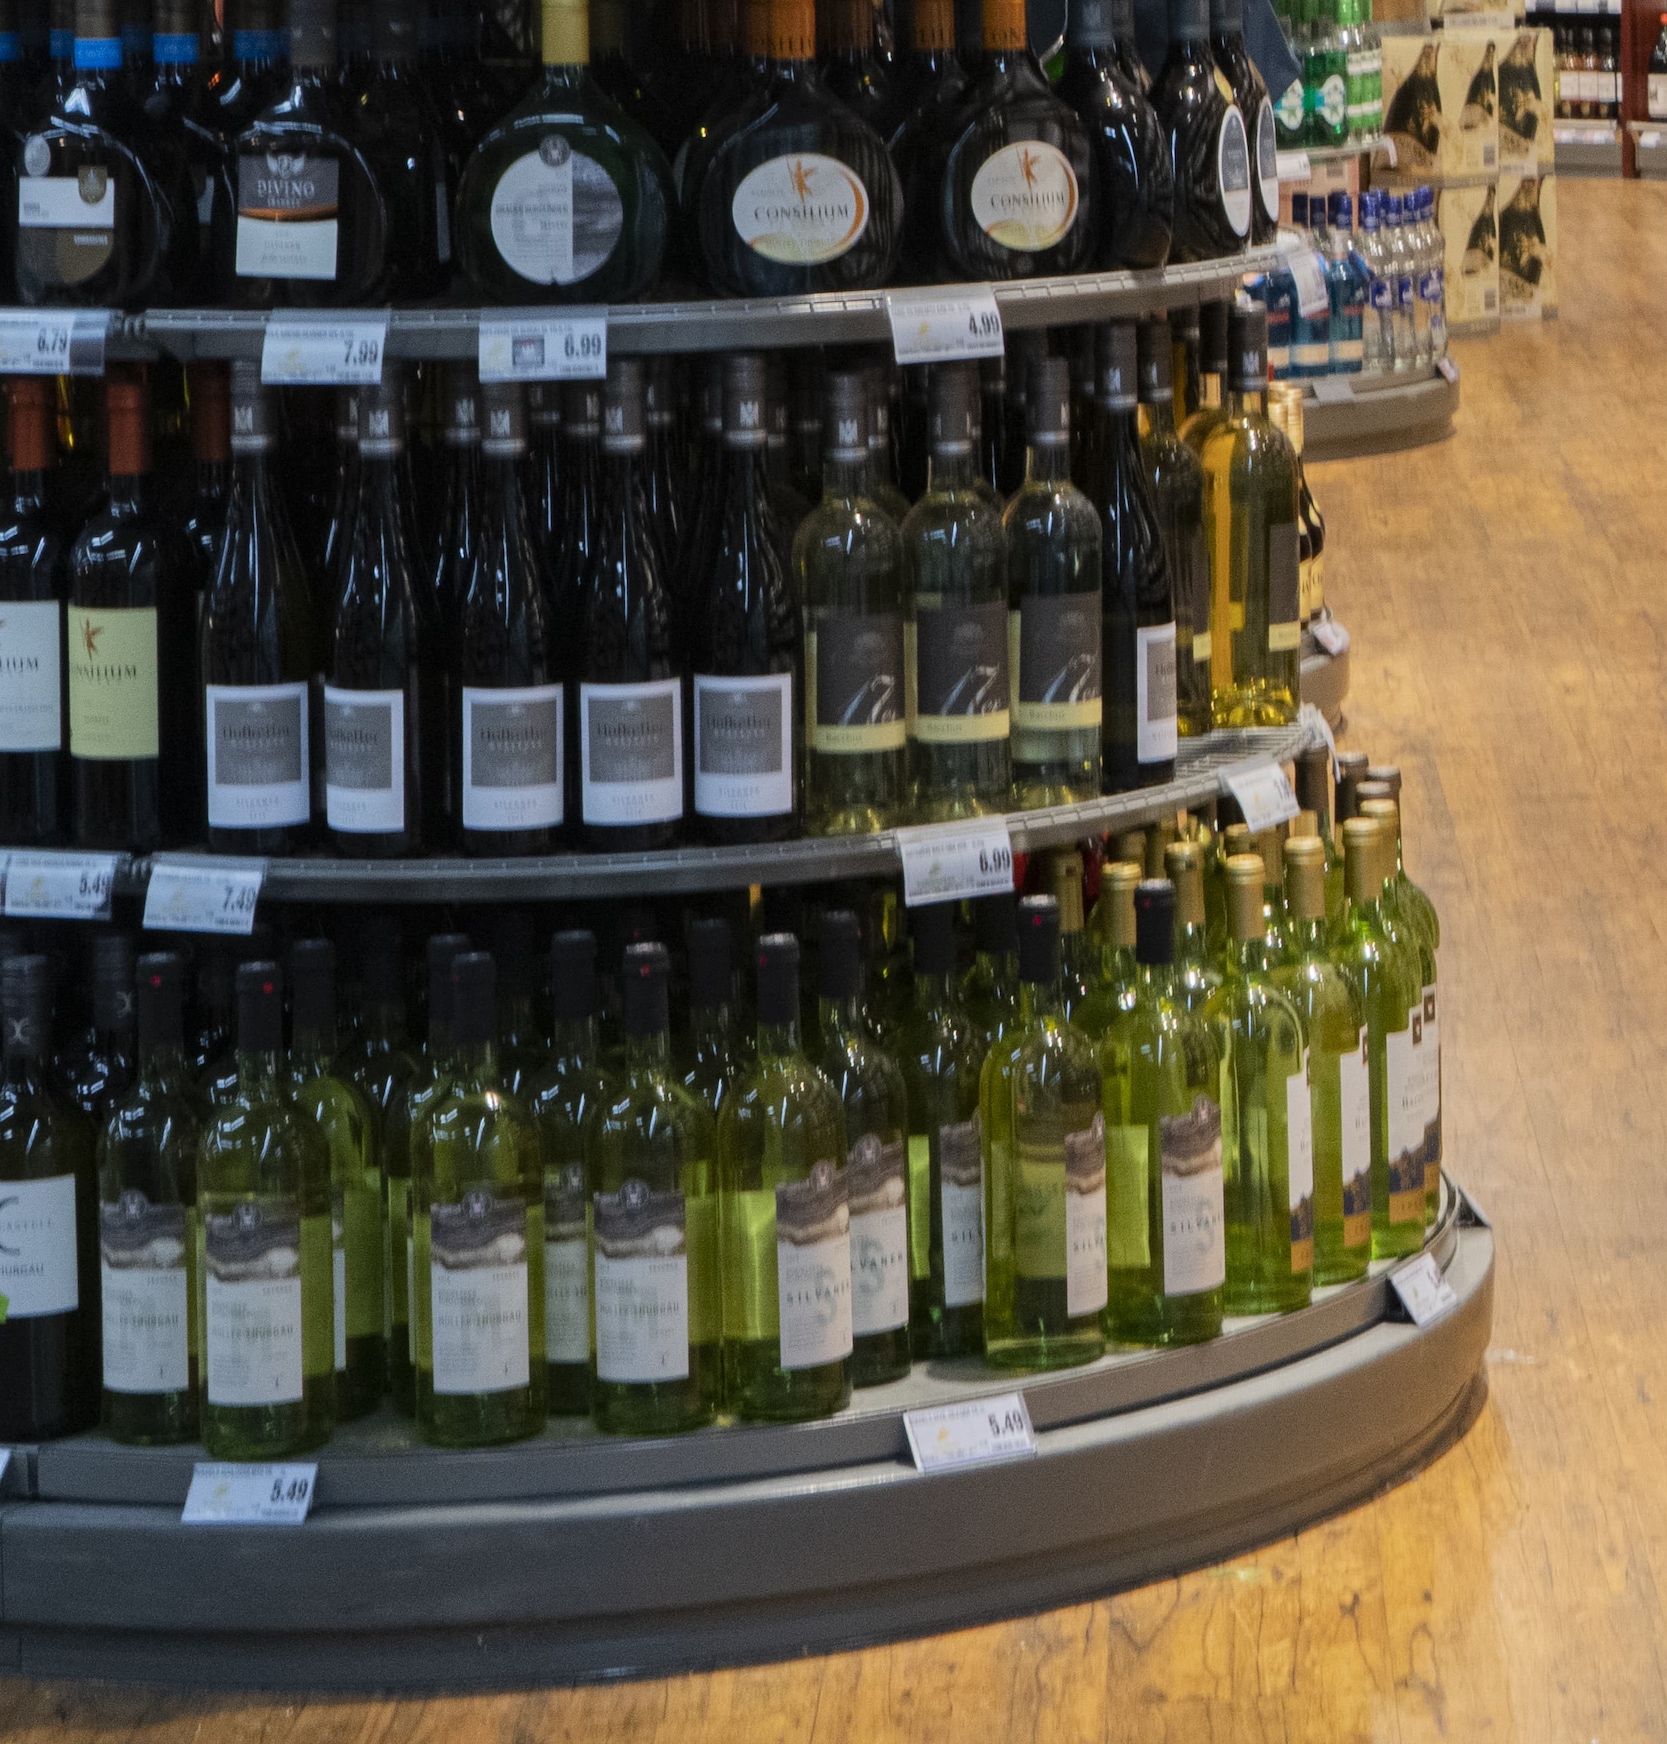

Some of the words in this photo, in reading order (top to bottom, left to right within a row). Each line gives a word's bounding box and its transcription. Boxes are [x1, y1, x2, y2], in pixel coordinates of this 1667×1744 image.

[256, 179, 317, 199] DIVINO
[988, 191, 1066, 212] CONSILIUM
[754, 202, 850, 223] CONSILIUM
[969, 311, 1002, 338] 4.99
[343, 338, 380, 366] 7.99
[563, 335, 603, 359] 6.99
[978, 846, 1013, 876] 6.99
[222, 886, 260, 912] 7.49
[987, 1410, 1025, 1438] 5.49
[270, 1476, 308, 1505] 5.49
